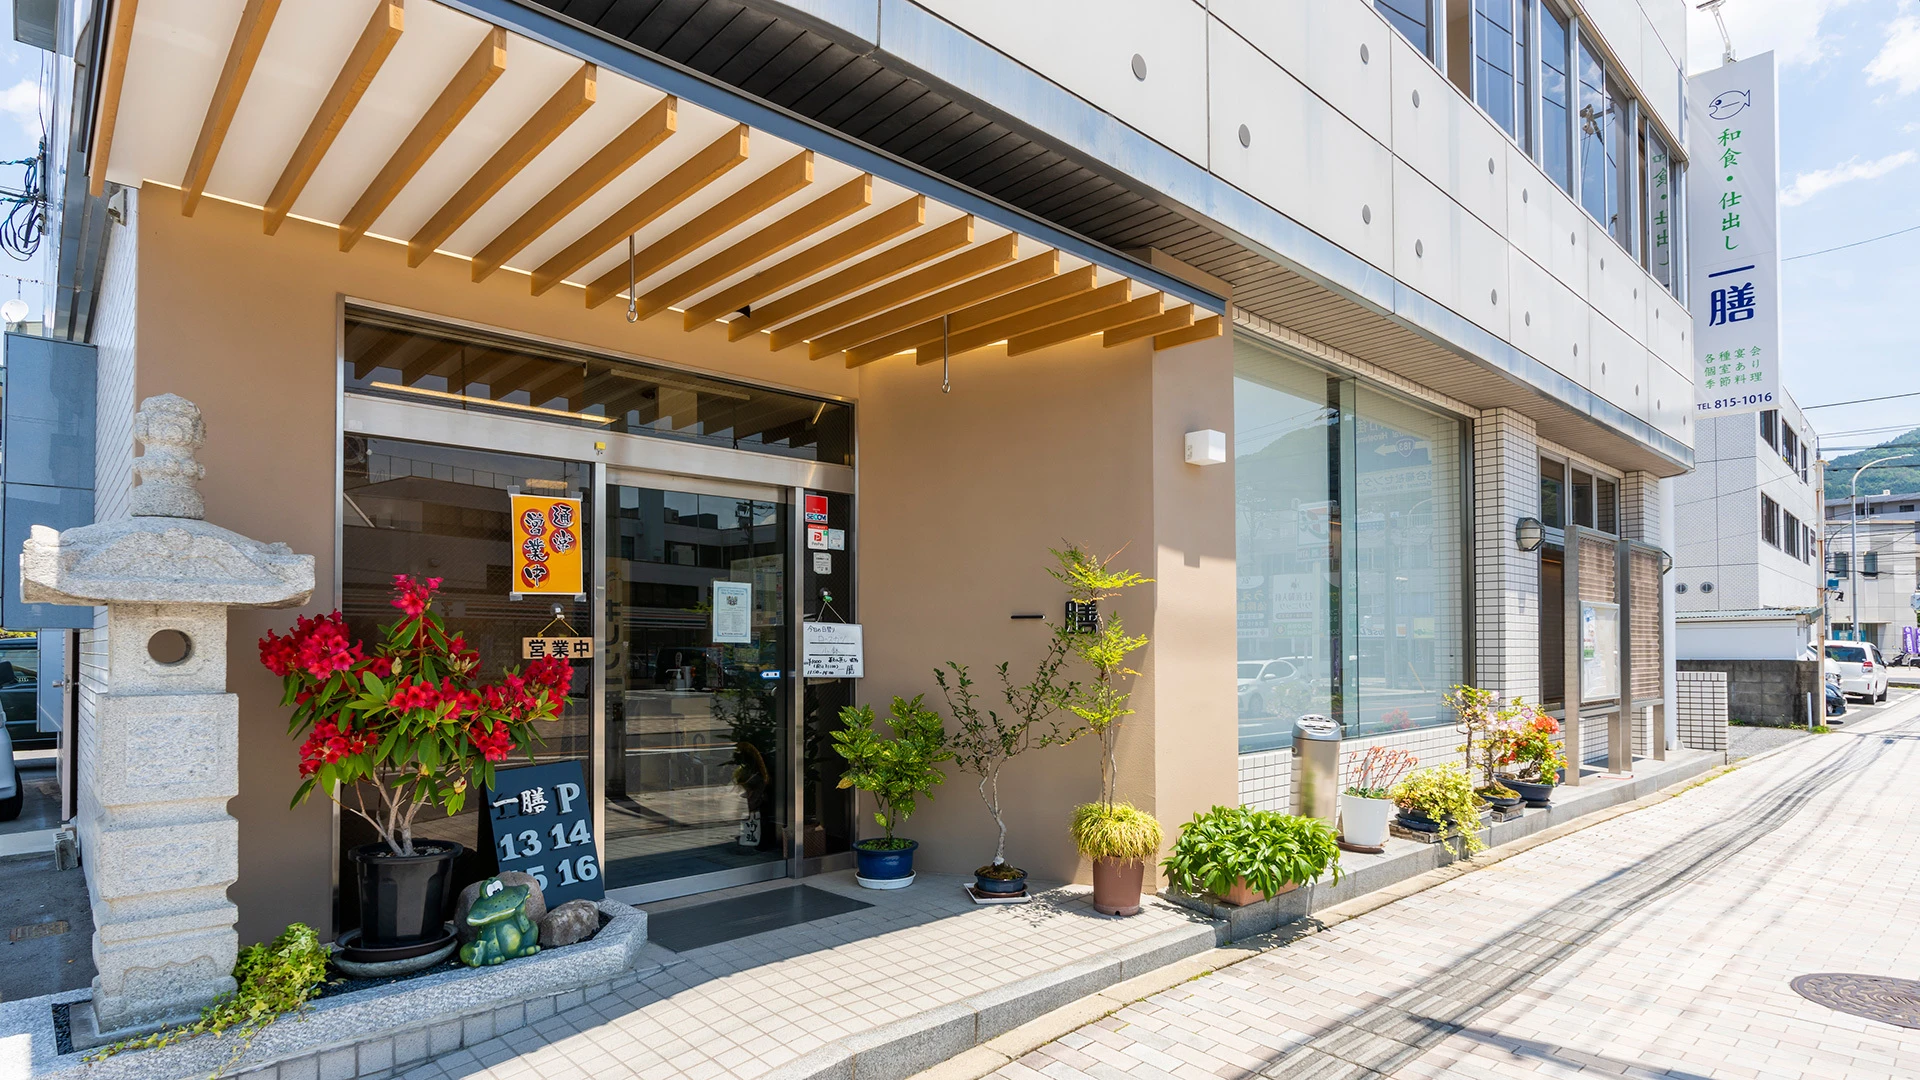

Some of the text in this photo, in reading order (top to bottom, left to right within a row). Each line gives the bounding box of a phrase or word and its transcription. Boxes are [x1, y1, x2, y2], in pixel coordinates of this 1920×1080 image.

[1718, 128, 1742, 250] 和食・仕出し
[1708, 264, 1756, 327] 一膳
[1704, 359, 1760, 377] 個室あり
[1705, 346, 1761, 363] 各種宴会
[1705, 371, 1762, 389] 季節料理
[1697, 392, 1772, 411] TEL 815-1016
[551, 503, 575, 554] 通常
[806, 513, 827, 521] SECOM
[524, 511, 548, 587] 営業中
[1010, 600, 1097, 634] 一膳
[528, 639, 590, 658] 営業中
[492, 782, 581, 814] 一膳 P
[499, 819, 592, 861] 13 14
[557, 855, 598, 886] 16
